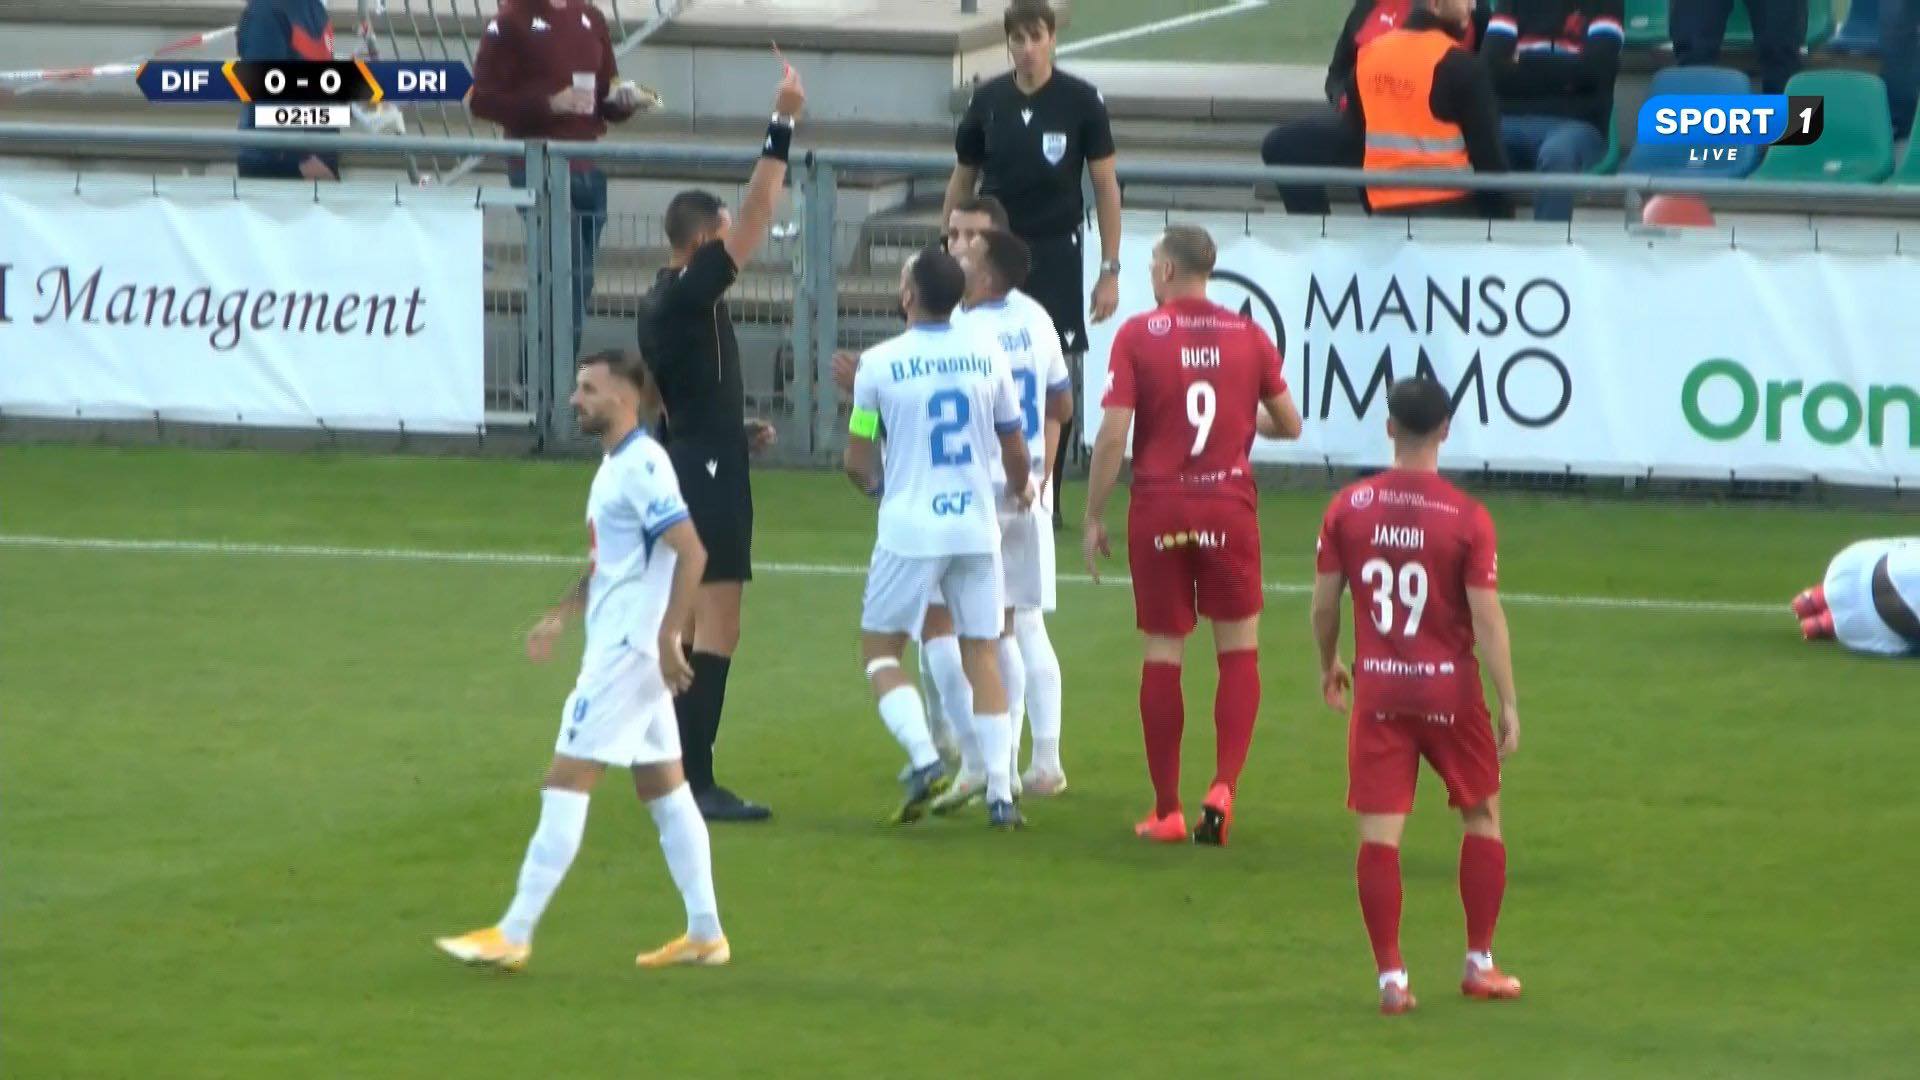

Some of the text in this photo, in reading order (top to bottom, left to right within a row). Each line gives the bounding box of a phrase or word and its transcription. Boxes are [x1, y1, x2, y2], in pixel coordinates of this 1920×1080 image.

[33, 265, 427, 352] Management
[1304, 272, 1571, 338] MANSO
[1181, 347, 1220, 368] BUCH
[1302, 341, 1572, 428] IMMO
[928, 388, 972, 466] 2
[1186, 380, 1216, 456] 9
[1681, 358, 1920, 448] Oron
[1371, 524, 1424, 550] JAKOBI
[1361, 559, 1428, 636] 39
